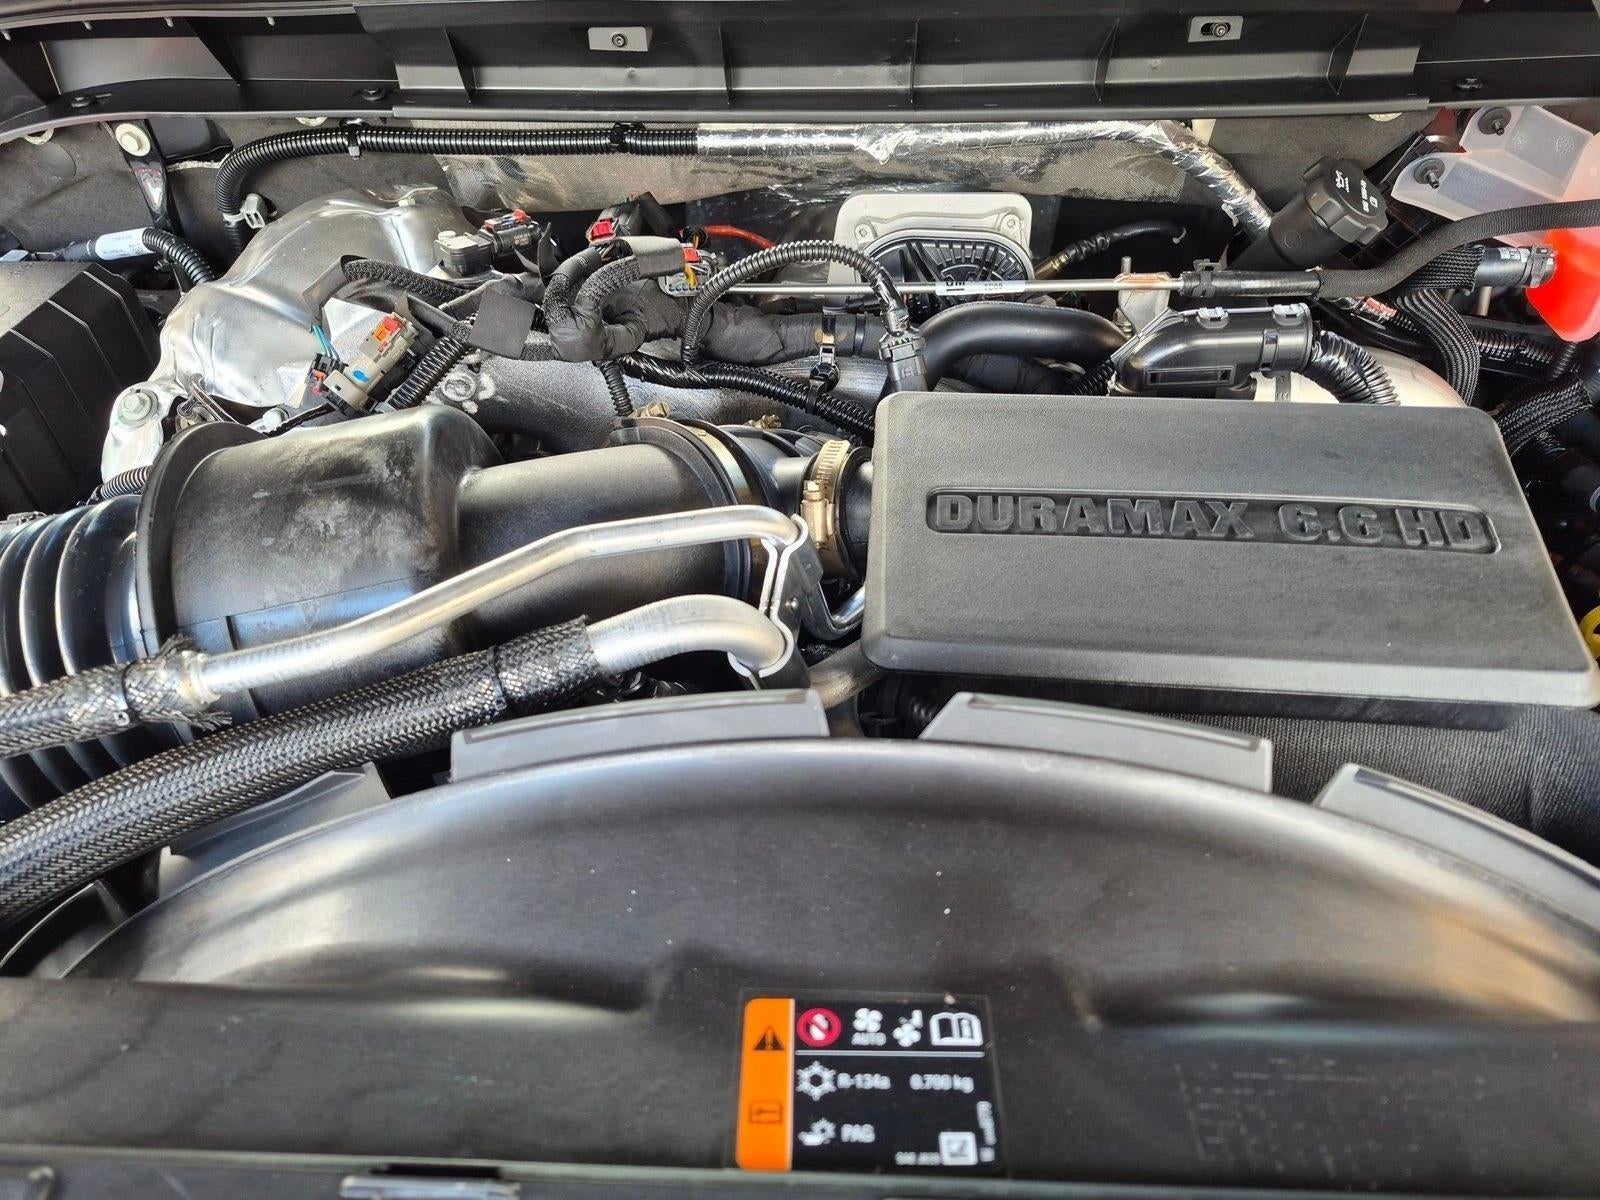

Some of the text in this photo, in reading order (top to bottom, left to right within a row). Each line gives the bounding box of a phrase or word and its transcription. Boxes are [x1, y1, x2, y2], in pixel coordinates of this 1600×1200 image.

[935, 494, 1489, 550] DURAMAX 6.6 HD
[837, 1073, 892, 1090] R-134a
[952, 1073, 975, 1094] kg
